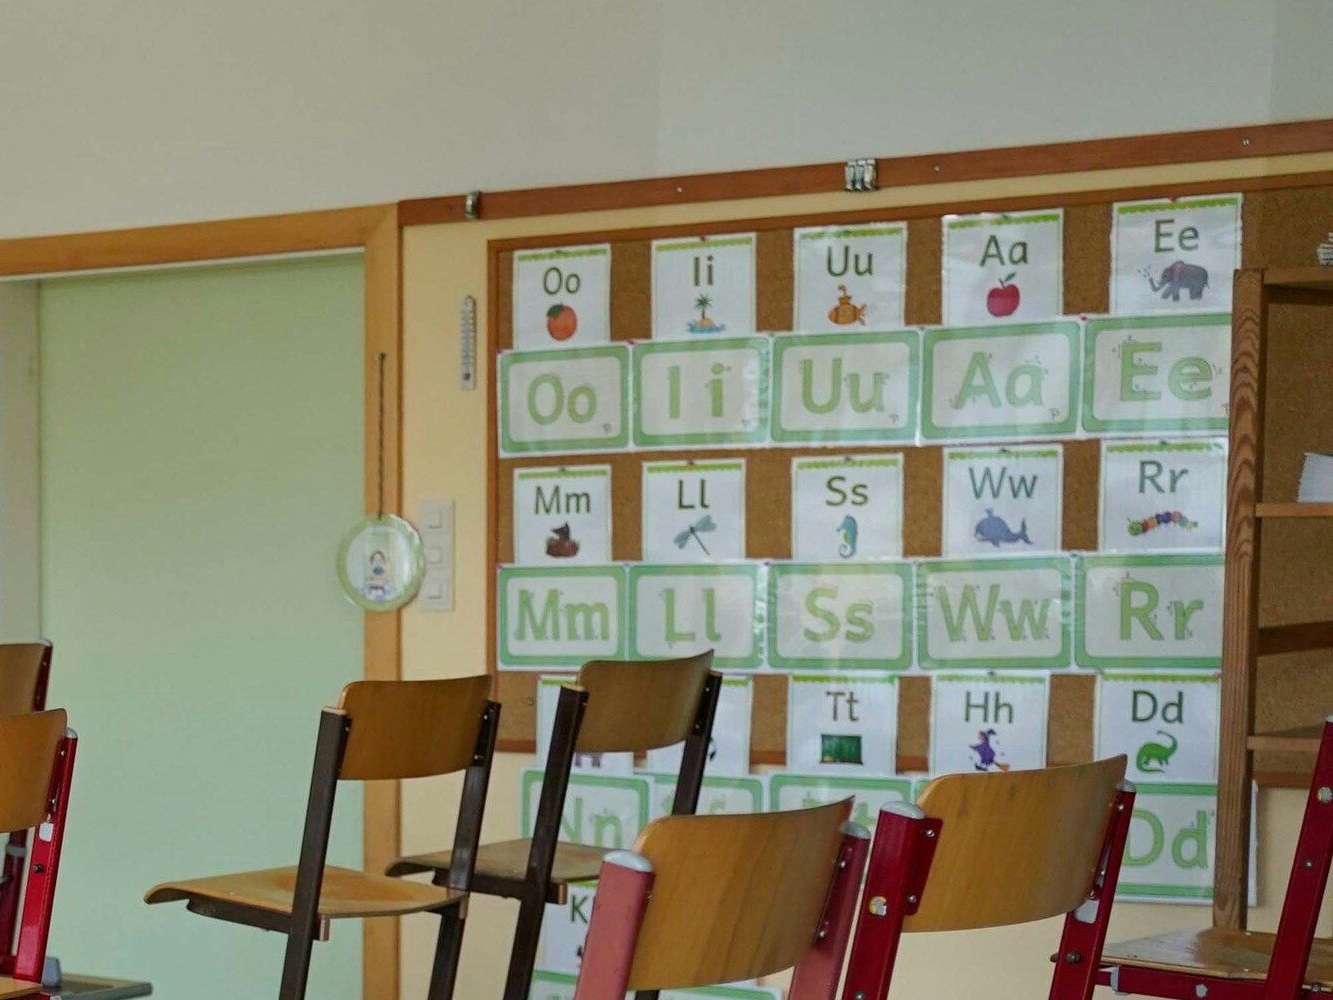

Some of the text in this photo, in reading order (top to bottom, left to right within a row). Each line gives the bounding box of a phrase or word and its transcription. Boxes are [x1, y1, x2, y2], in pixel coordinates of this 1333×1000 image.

[980, 234, 1029, 268] Aa
[1154, 218, 1199, 253] Ee
[693, 255, 715, 287] Ii
[826, 245, 874, 277] Uu
[542, 266, 581, 296] Oo
[801, 356, 885, 416] Uu
[954, 351, 1044, 410] Aa
[1120, 341, 1213, 402] Ee
[527, 372, 598, 426] Oo
[677, 478, 710, 510] Ll
[825, 475, 869, 507] Ss
[968, 466, 1038, 500] Ww
[1137, 460, 1190, 494] Rr
[534, 484, 591, 515] Mm
[516, 588, 610, 643] Mm
[664, 587, 722, 643] Ll
[803, 586, 875, 643] Ss
[936, 583, 1051, 643] Ww
[1119, 580, 1205, 642] Rr
[826, 691, 860, 722] Tt
[964, 690, 1014, 724] Hh
[1131, 689, 1185, 724] Dd
[1121, 808, 1209, 869] Dd
